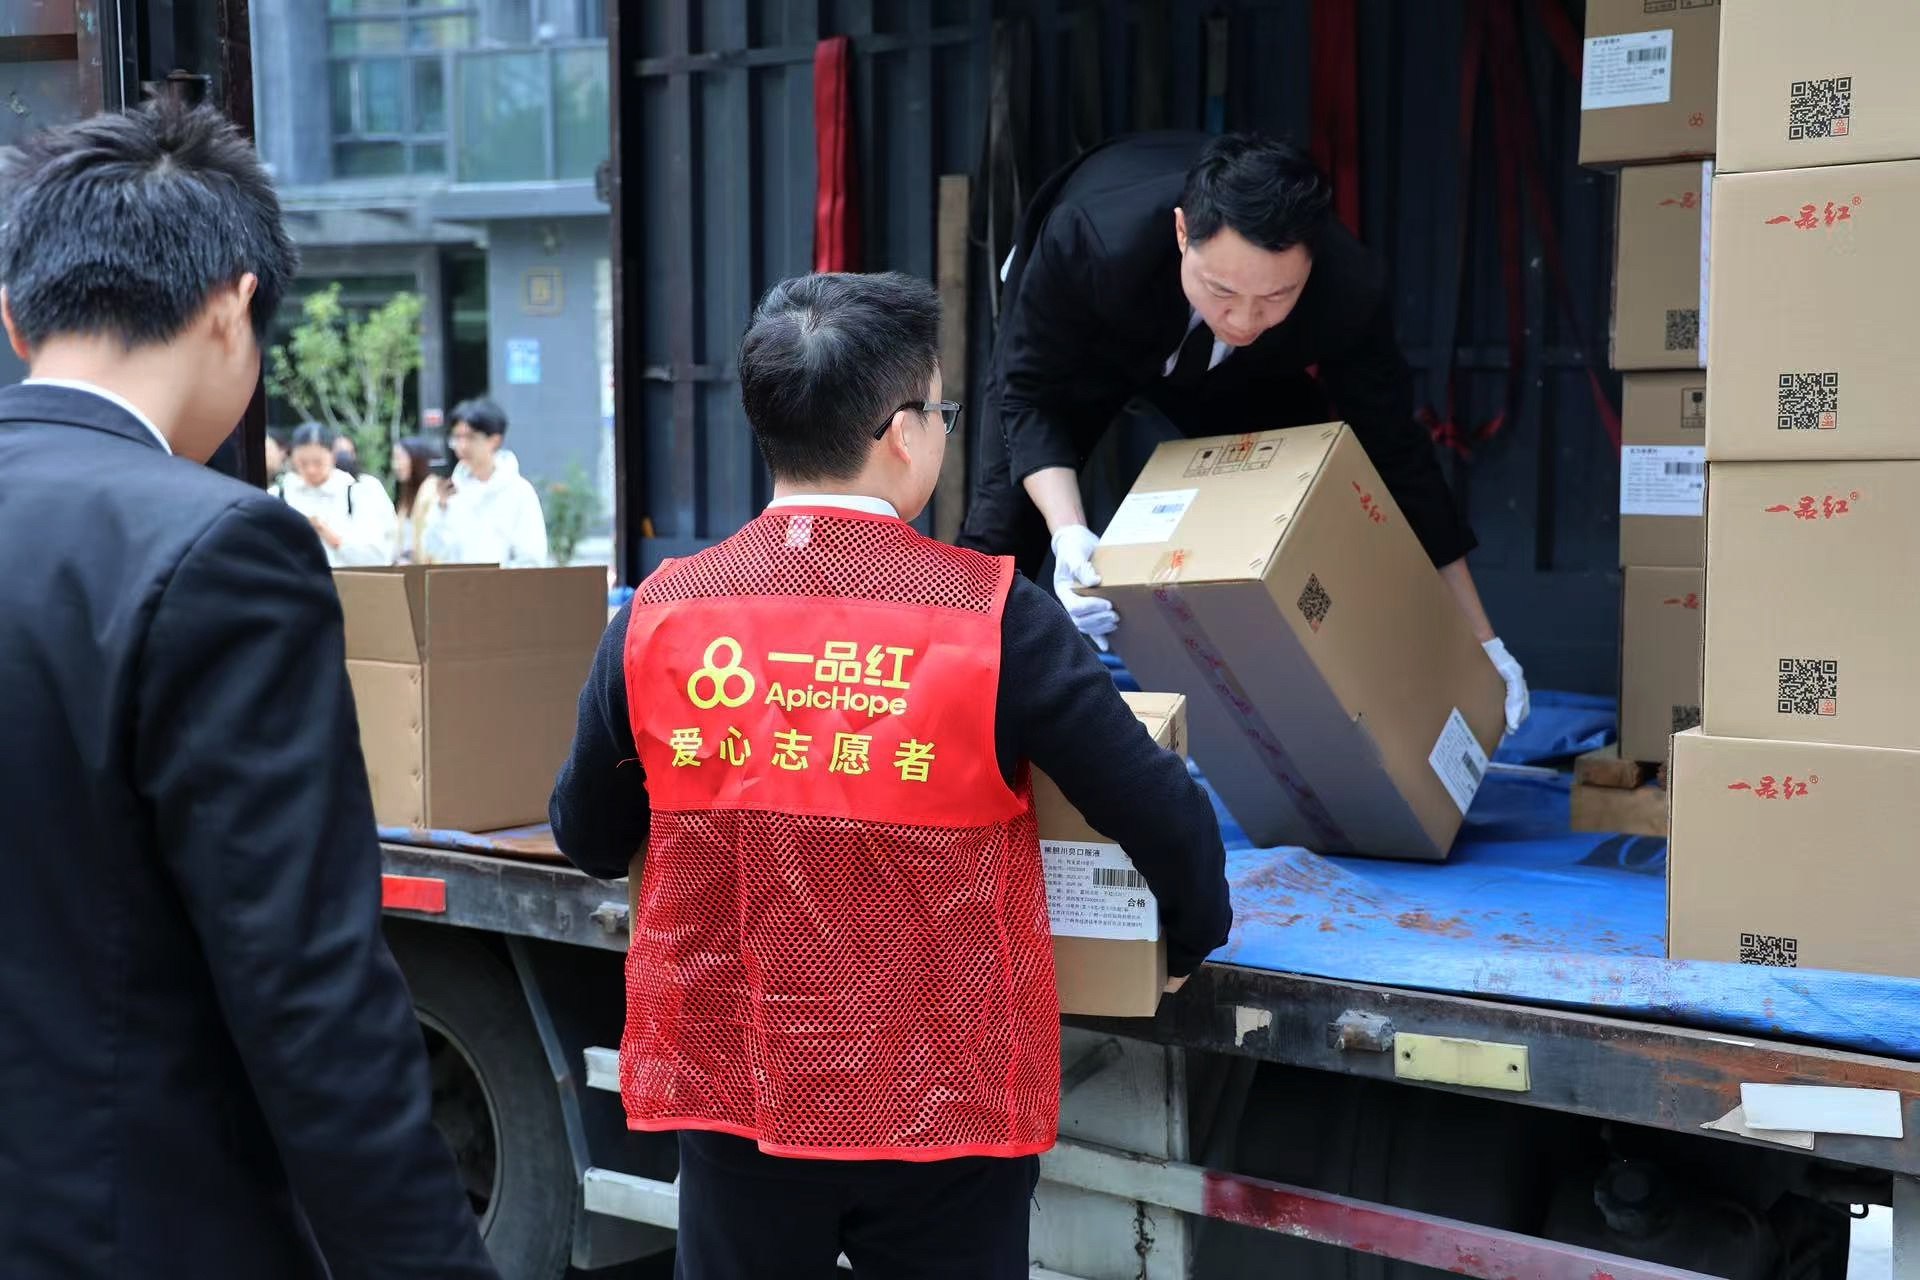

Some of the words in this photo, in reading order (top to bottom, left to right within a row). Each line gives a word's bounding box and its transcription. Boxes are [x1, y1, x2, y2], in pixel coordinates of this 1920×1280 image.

[767, 640, 914, 689] 一品红
[764, 682, 908, 717] ApicHope
[669, 726, 936, 782] 爱心志愿者
[1127, 897, 1146, 908] 合格
